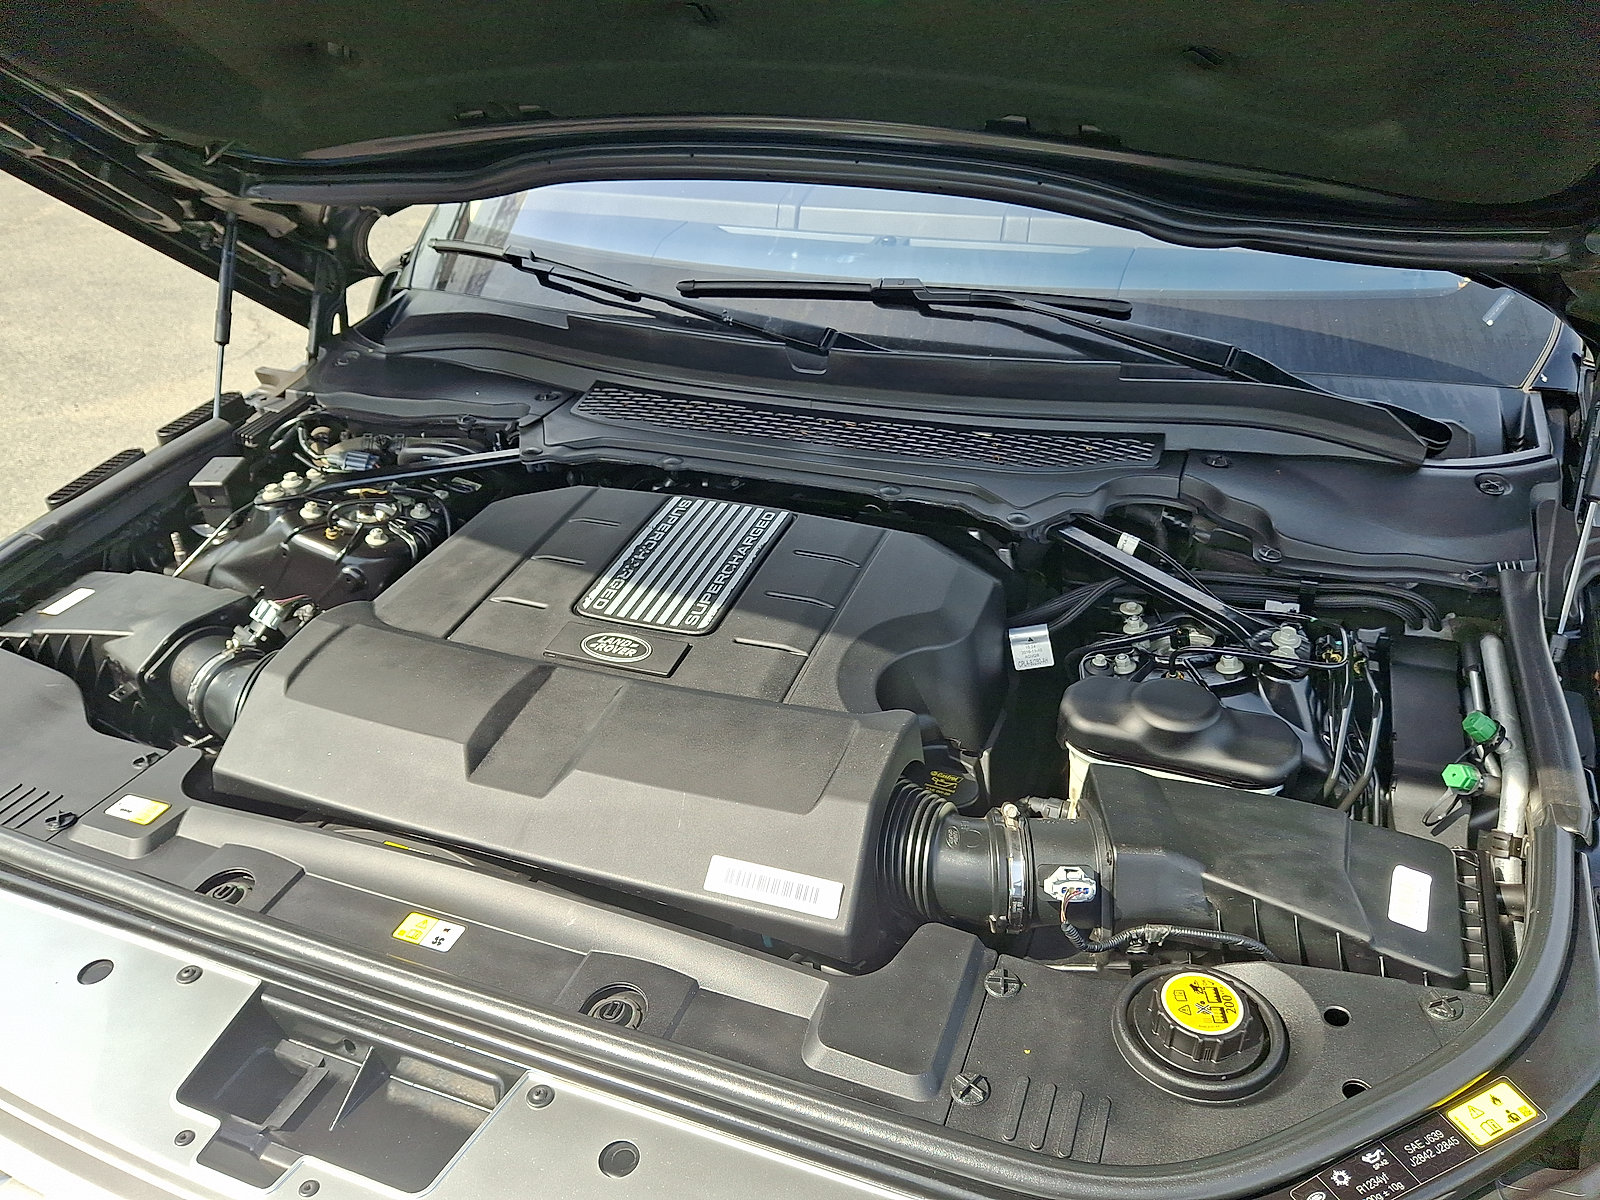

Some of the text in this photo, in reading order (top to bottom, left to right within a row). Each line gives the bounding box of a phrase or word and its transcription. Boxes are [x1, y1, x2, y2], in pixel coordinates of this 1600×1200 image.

[593, 499, 692, 610] SUPERCHARGED
[685, 511, 776, 626] SUPERCHARGED
[593, 643, 638, 657] ROVER
[597, 635, 633, 647] LAND
[1221, 995, 1237, 1014] 200
[1404, 1139, 1425, 1154] SAE
[1423, 1129, 1445, 1148] J639
[1410, 1136, 1460, 1167] J2842 J2845
[1355, 1172, 1389, 1195] R1234yf
[1388, 1182, 1405, 1193] 10g
